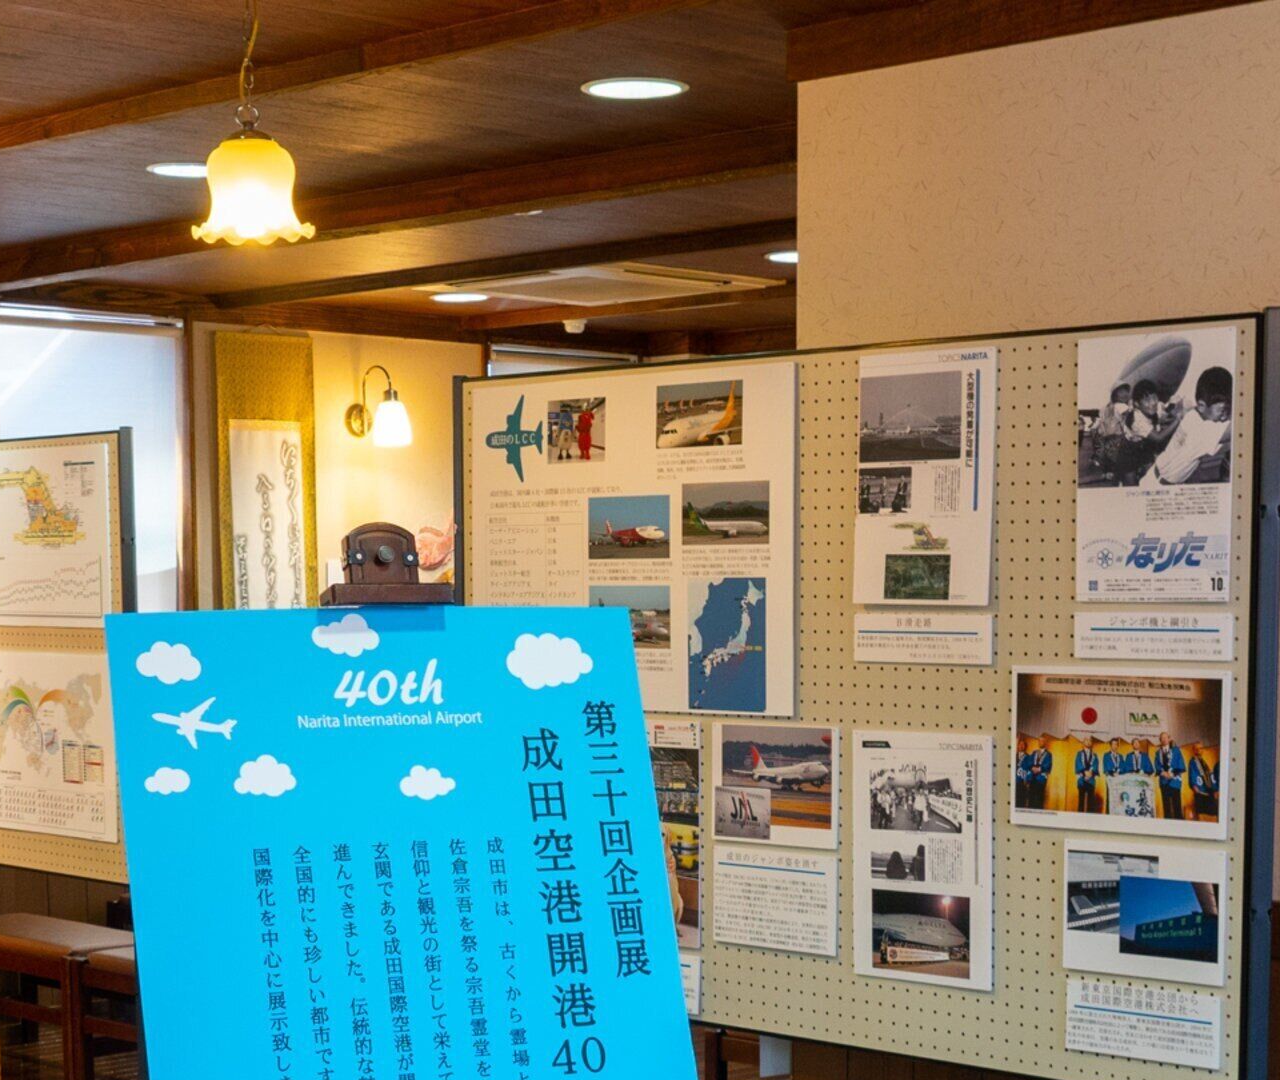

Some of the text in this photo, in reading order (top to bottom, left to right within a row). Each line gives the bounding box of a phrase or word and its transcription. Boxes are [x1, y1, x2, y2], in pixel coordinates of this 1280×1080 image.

[1125, 530, 1209, 573] なりた
[1210, 577, 1224, 592] 10
[333, 658, 445, 709] 40th
[297, 708, 483, 730] Narita International Airport
[1128, 711, 1161, 724] NAA
[582, 700, 652, 978] 第三十回企画展
